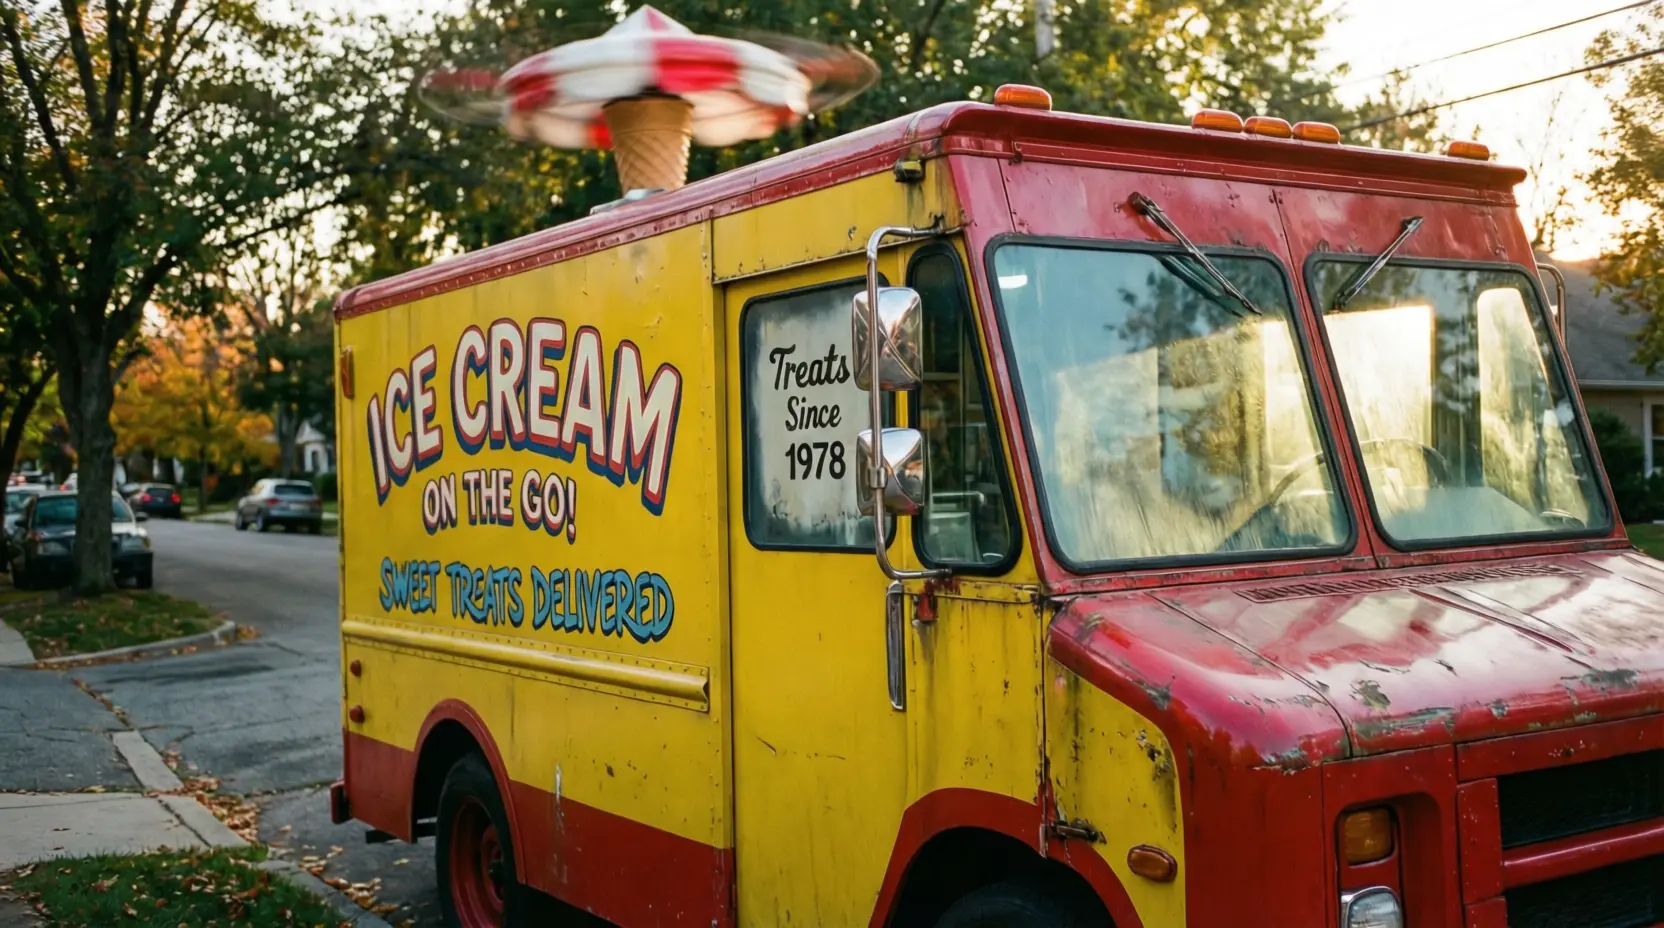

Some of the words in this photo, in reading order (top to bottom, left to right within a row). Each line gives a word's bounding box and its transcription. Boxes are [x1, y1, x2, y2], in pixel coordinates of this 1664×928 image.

[769, 344, 850, 390] Treats
[367, 344, 443, 507] ICE
[451, 317, 683, 516] CREAM
[785, 396, 842, 432] Since
[785, 441, 846, 480] 1978
[422, 473, 457, 536] ON
[463, 469, 514, 527] THE
[521, 469, 577, 545] GO!
[379, 556, 441, 614] SWEET
[445, 561, 525, 629] TREATS
[531, 566, 675, 644] DELIVERED
